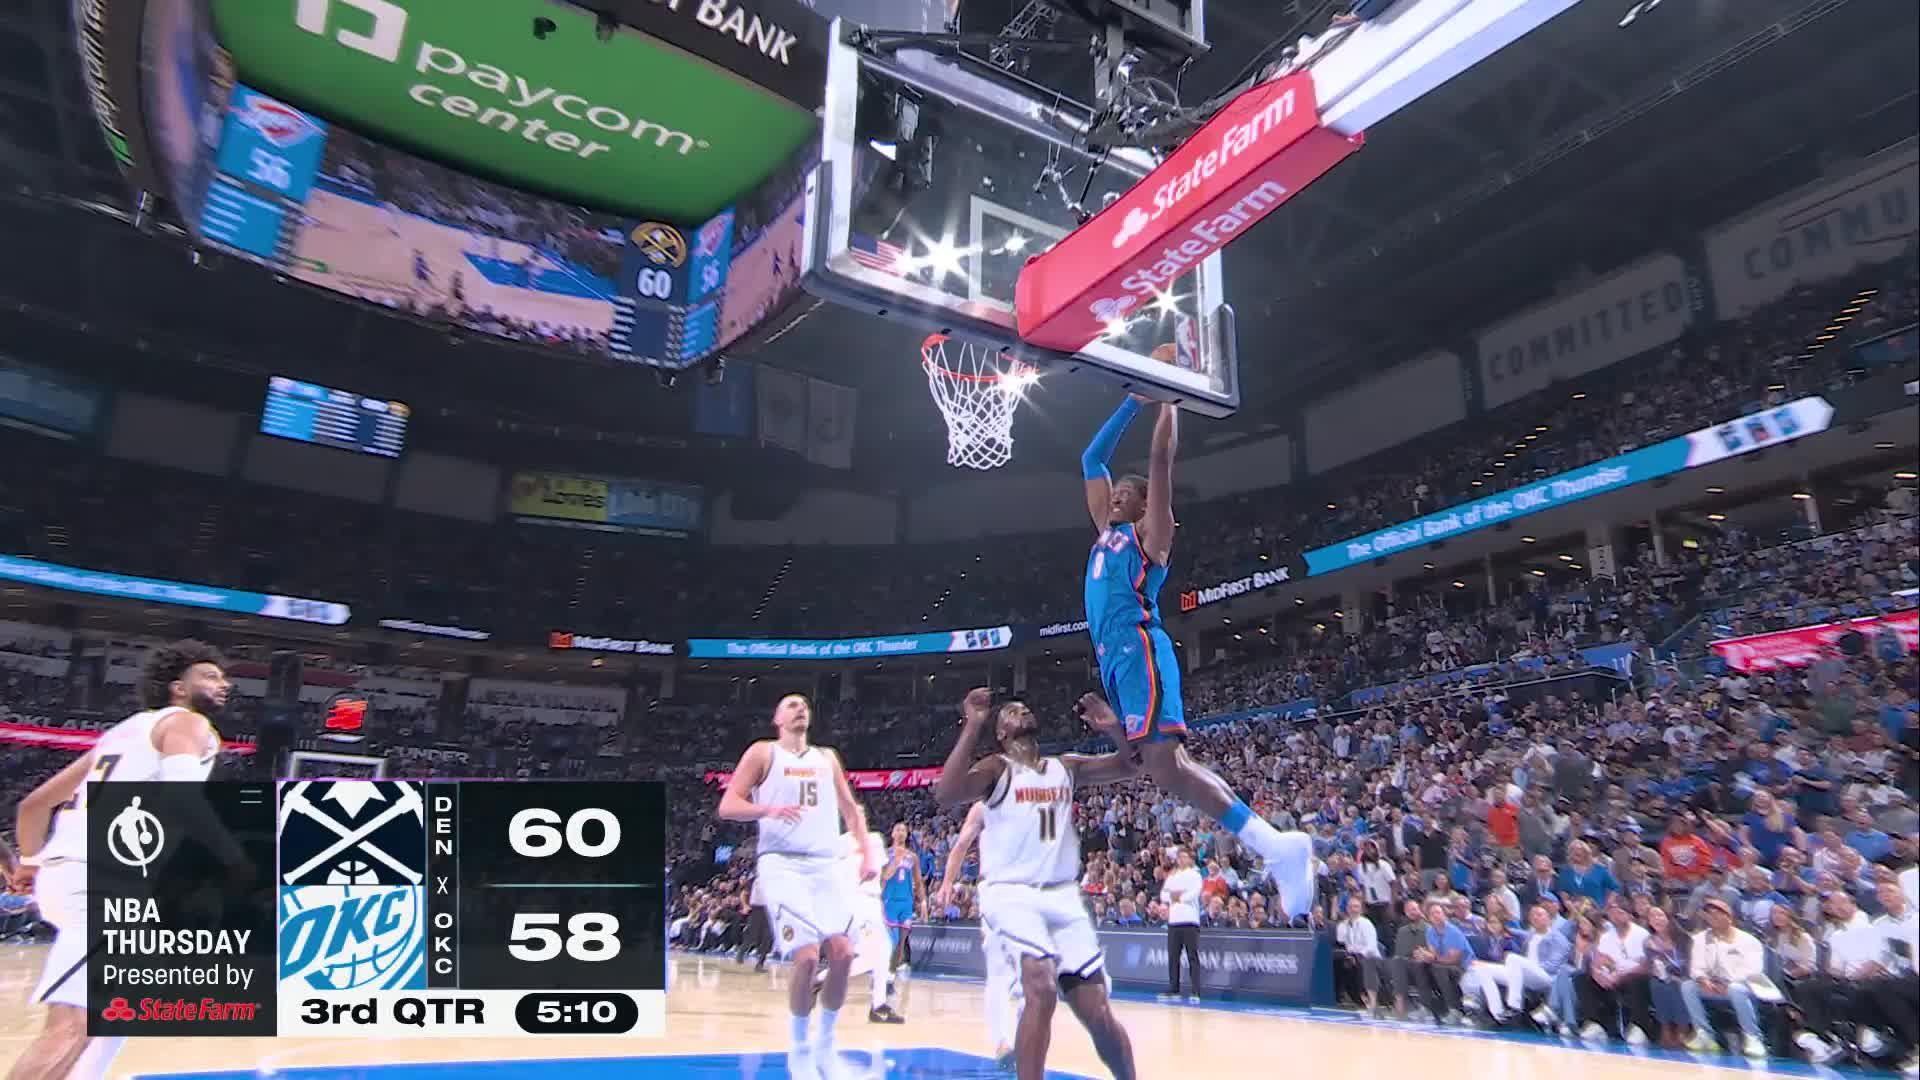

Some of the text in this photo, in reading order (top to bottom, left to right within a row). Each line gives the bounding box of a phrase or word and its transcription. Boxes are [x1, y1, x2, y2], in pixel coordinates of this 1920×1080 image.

[695, 0, 797, 65] BANK
[408, 84, 610, 159] center
[416, 41, 694, 155] paycom
[637, 267, 673, 299] 60
[1489, 280, 1683, 383] COMMITTED
[1347, 542, 1371, 561] The
[1423, 512, 1462, 537] Bank
[1463, 504, 1481, 526] of
[1483, 500, 1513, 520] the
[1550, 465, 1629, 498] Thunder
[727, 642, 748, 655] The
[749, 642, 788, 655] Official
[789, 642, 818, 655] Bank
[819, 641, 833, 655] of
[833, 641, 851, 654] the
[876, 638, 918, 653] Thunder
[800, 780, 818, 807] 15
[1039, 806, 1055, 841] 11
